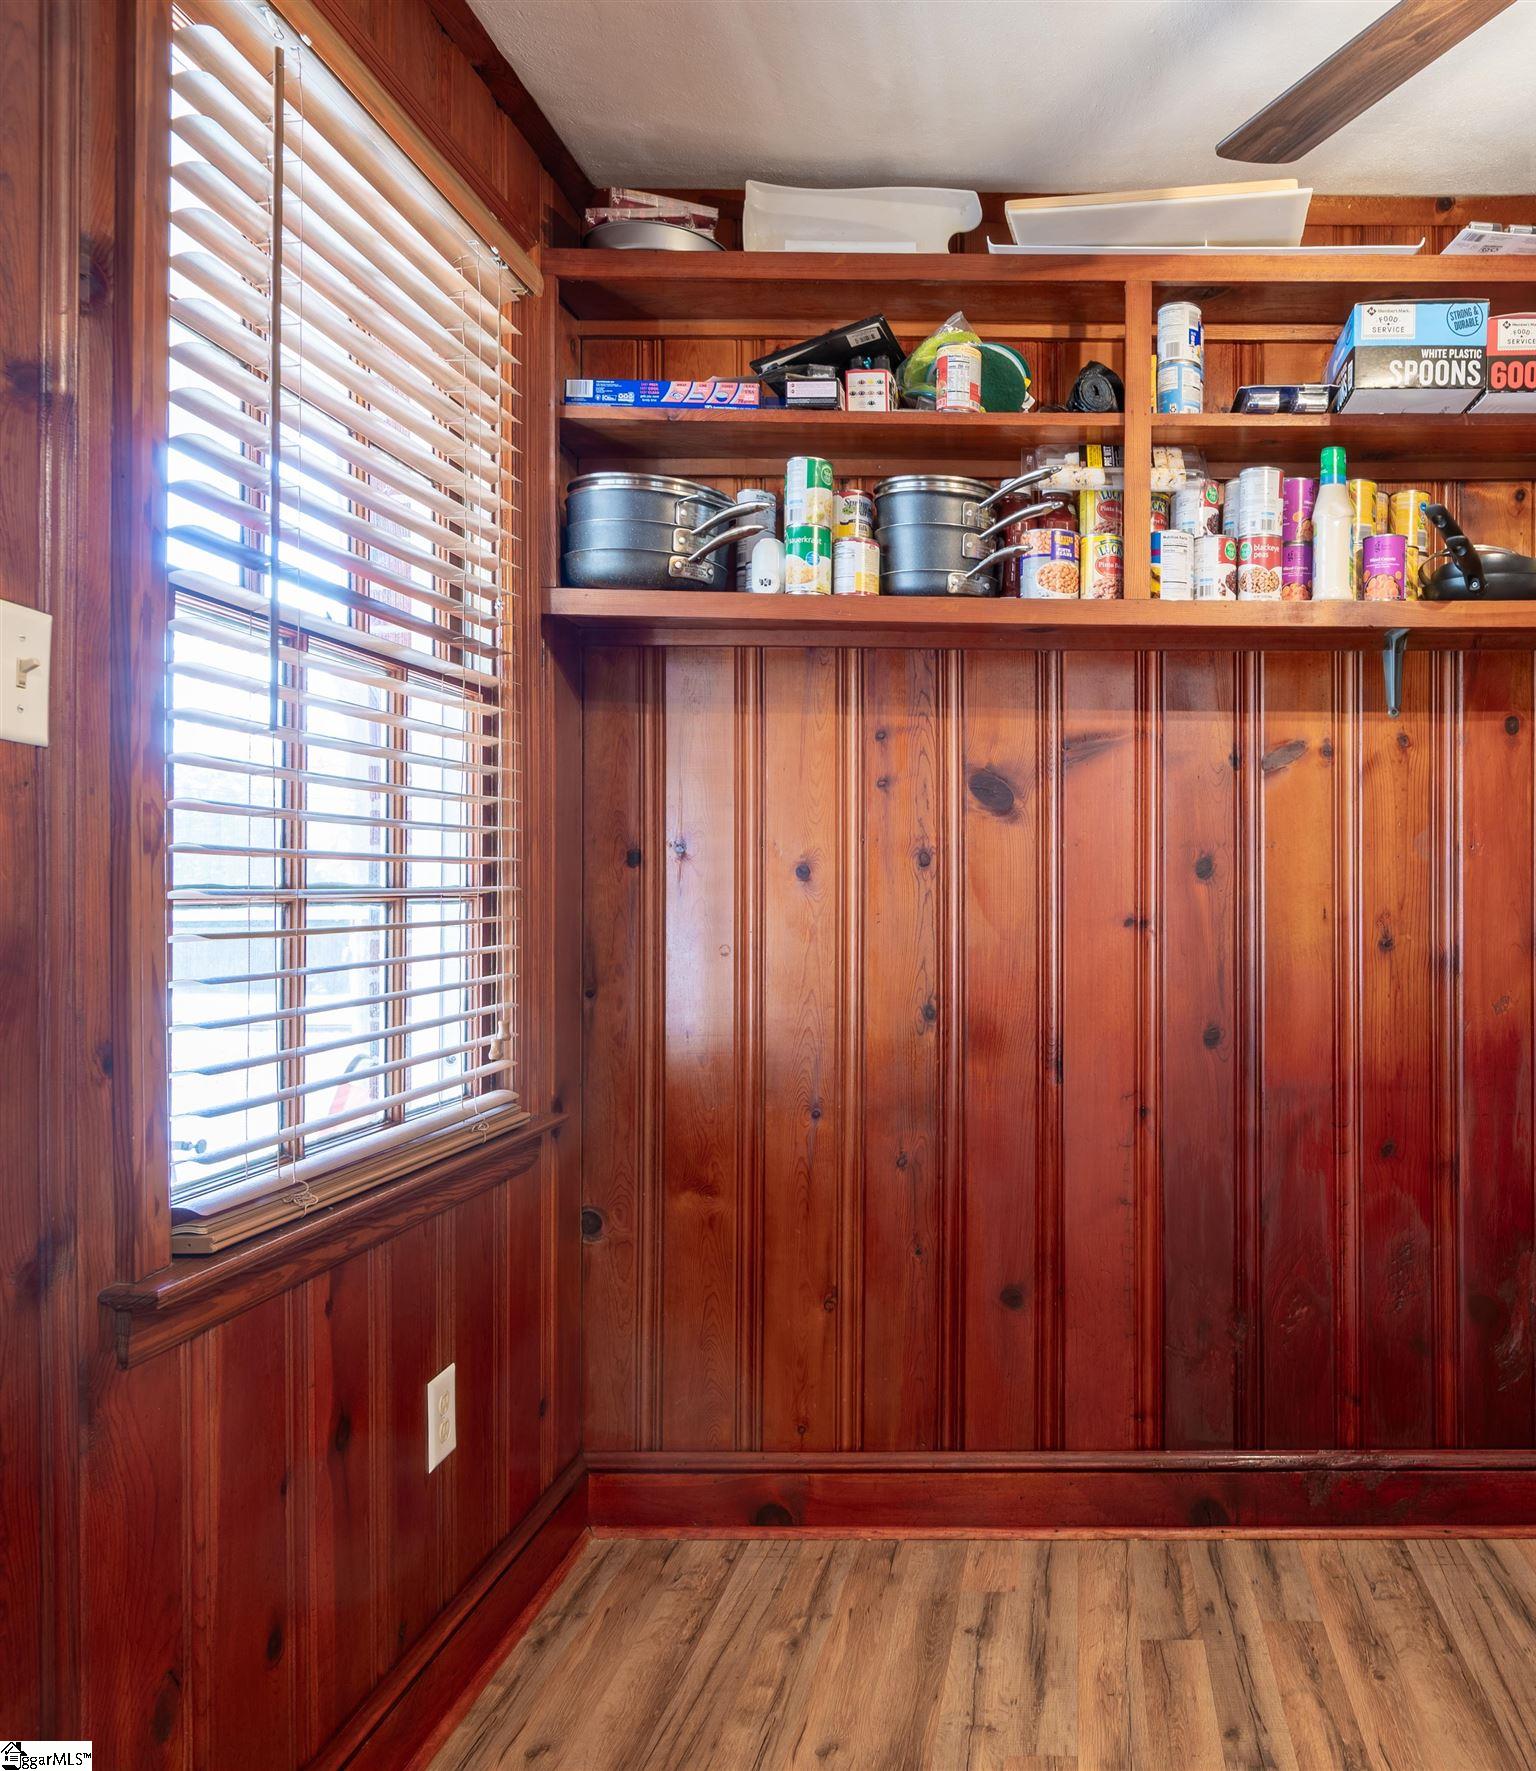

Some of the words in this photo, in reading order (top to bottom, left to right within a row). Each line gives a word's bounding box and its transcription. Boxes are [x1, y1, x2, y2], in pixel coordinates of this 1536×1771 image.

[1449, 307, 1473, 322] STRONG
[1473, 305, 1479, 316] &
[1378, 315, 1399, 323] FOOD
[1453, 316, 1480, 331] DURABLE
[1371, 326, 1405, 334] SERVICE
[1421, 349, 1447, 359] WHITE
[1448, 349, 1482, 359] PLASTIC
[1389, 359, 1481, 386] SPOONS
[790, 535, 822, 545] sauerkraut
[1253, 543, 1280, 552] blackeye
